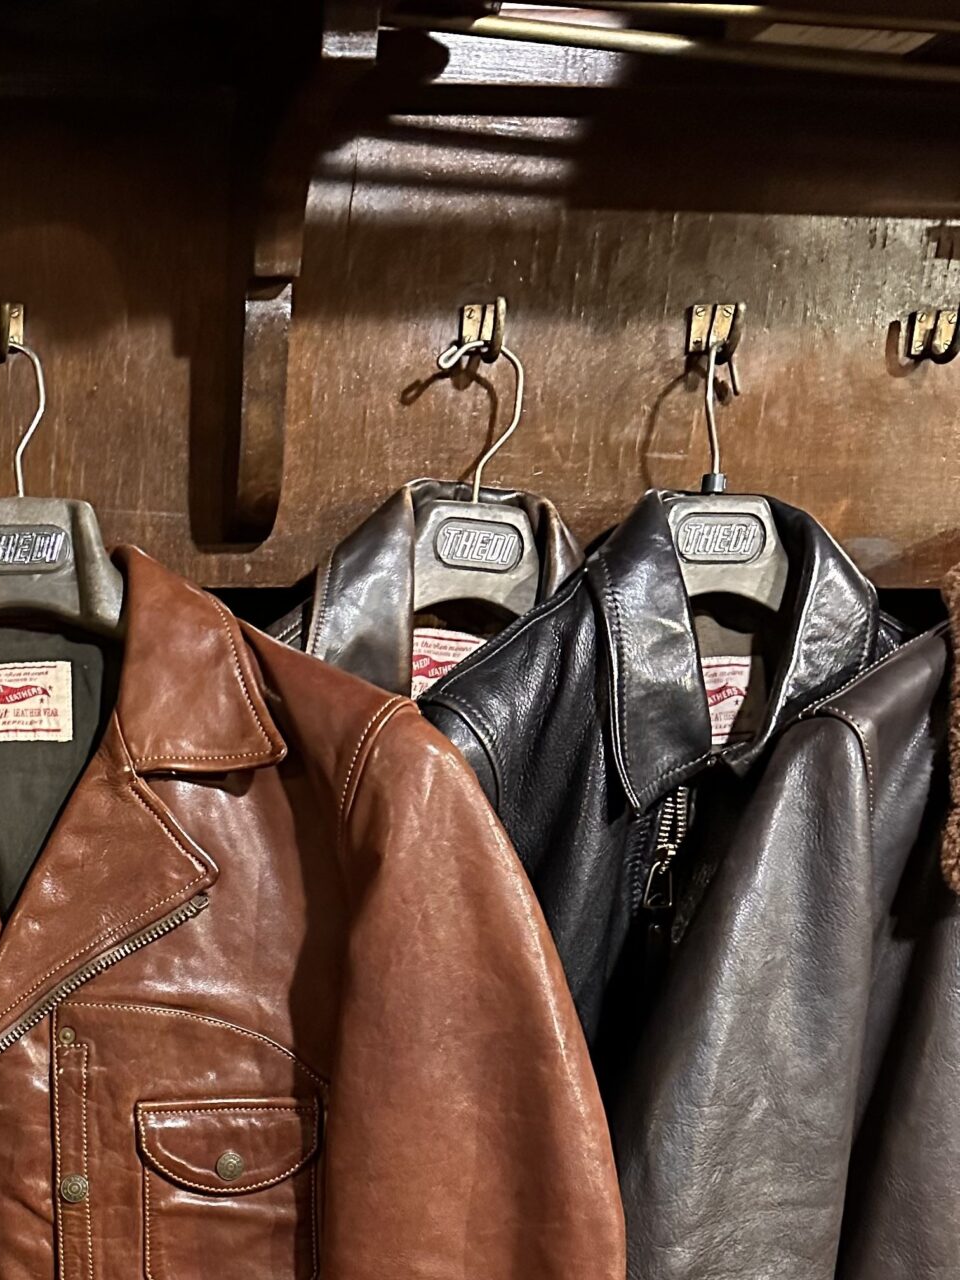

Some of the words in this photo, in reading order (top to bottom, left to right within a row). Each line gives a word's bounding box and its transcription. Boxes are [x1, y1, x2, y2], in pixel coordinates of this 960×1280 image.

[441, 527, 517, 565] THEDI
[682, 523, 758, 555] THEDI
[413, 657, 431, 671] HEDI
[5, 687, 43, 703] LEATHERS
[13, 708, 41, 717] LEATHER
